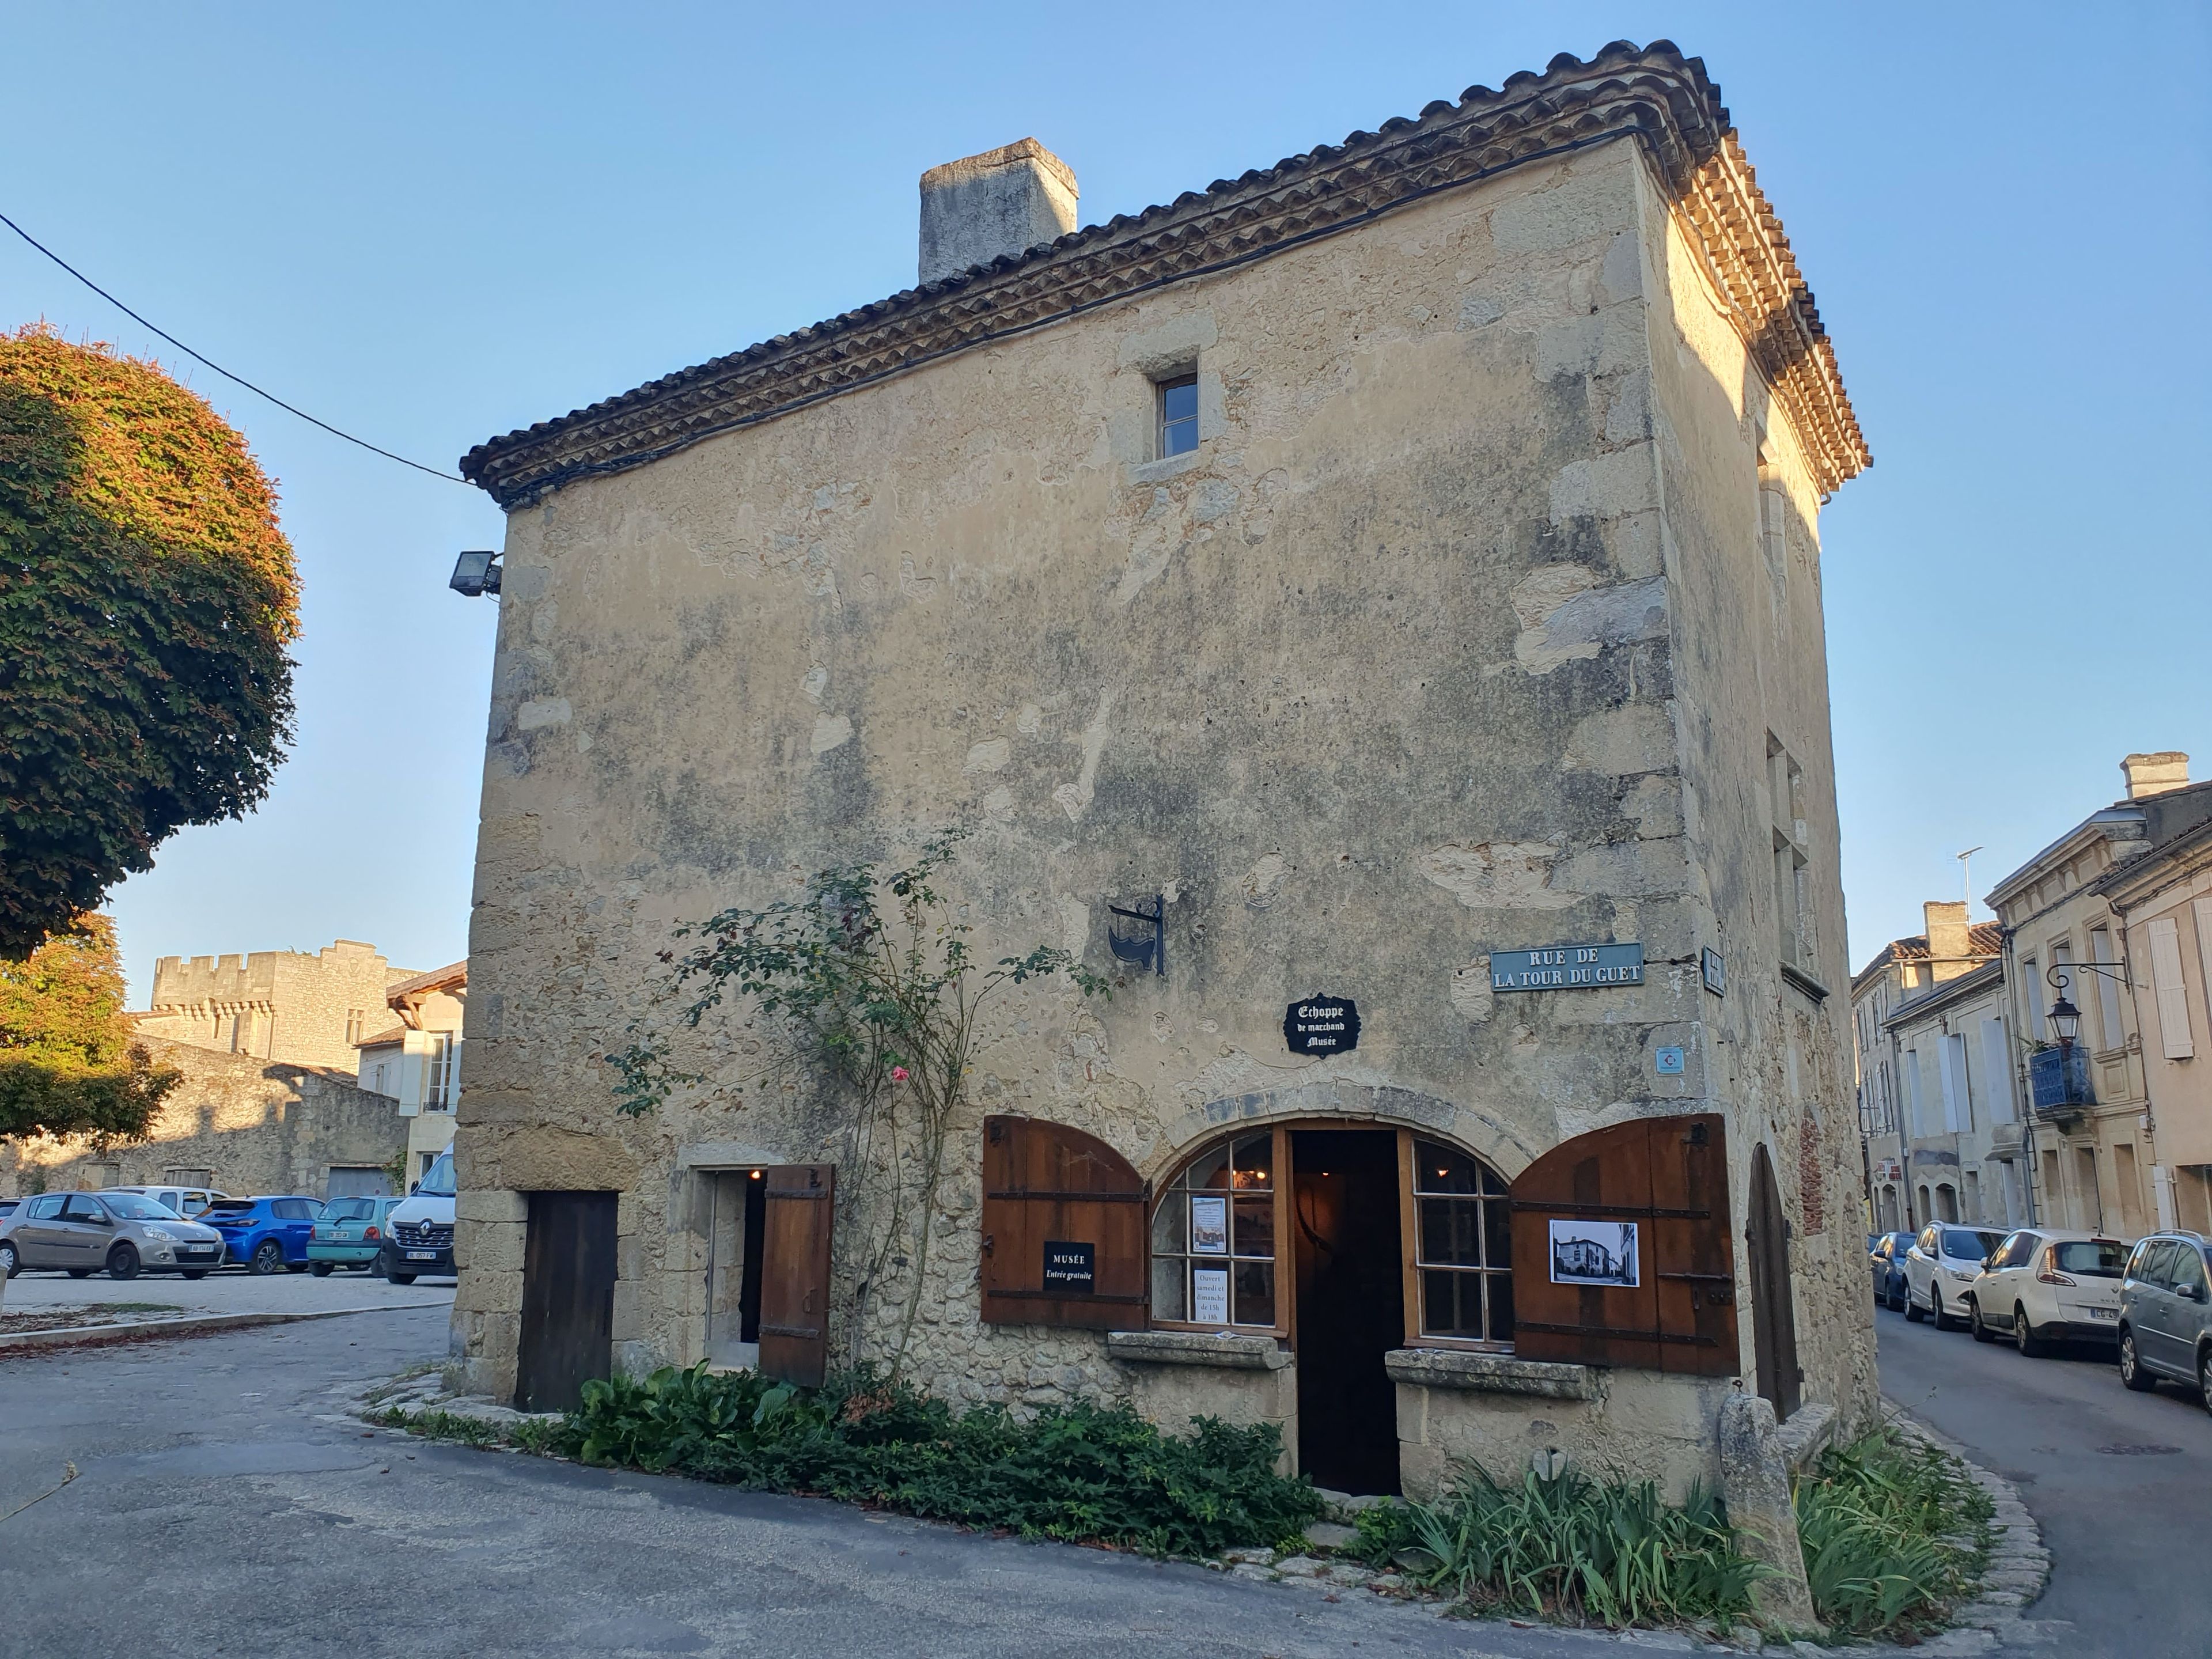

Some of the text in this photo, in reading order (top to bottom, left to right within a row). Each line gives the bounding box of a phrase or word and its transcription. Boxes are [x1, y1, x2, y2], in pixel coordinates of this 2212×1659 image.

[1529, 948, 1598, 965] RUE DE
[1494, 965, 1640, 987] LA TOUR DU GUET
[1298, 1005, 1344, 1019] Echoppe
[1297, 1022, 1345, 1032] de marchand
[1306, 1036, 1336, 1047] Musée
[1053, 1254, 1085, 1264] MUSÉE
[1047, 1269, 1092, 1281] Entrée gratuite
